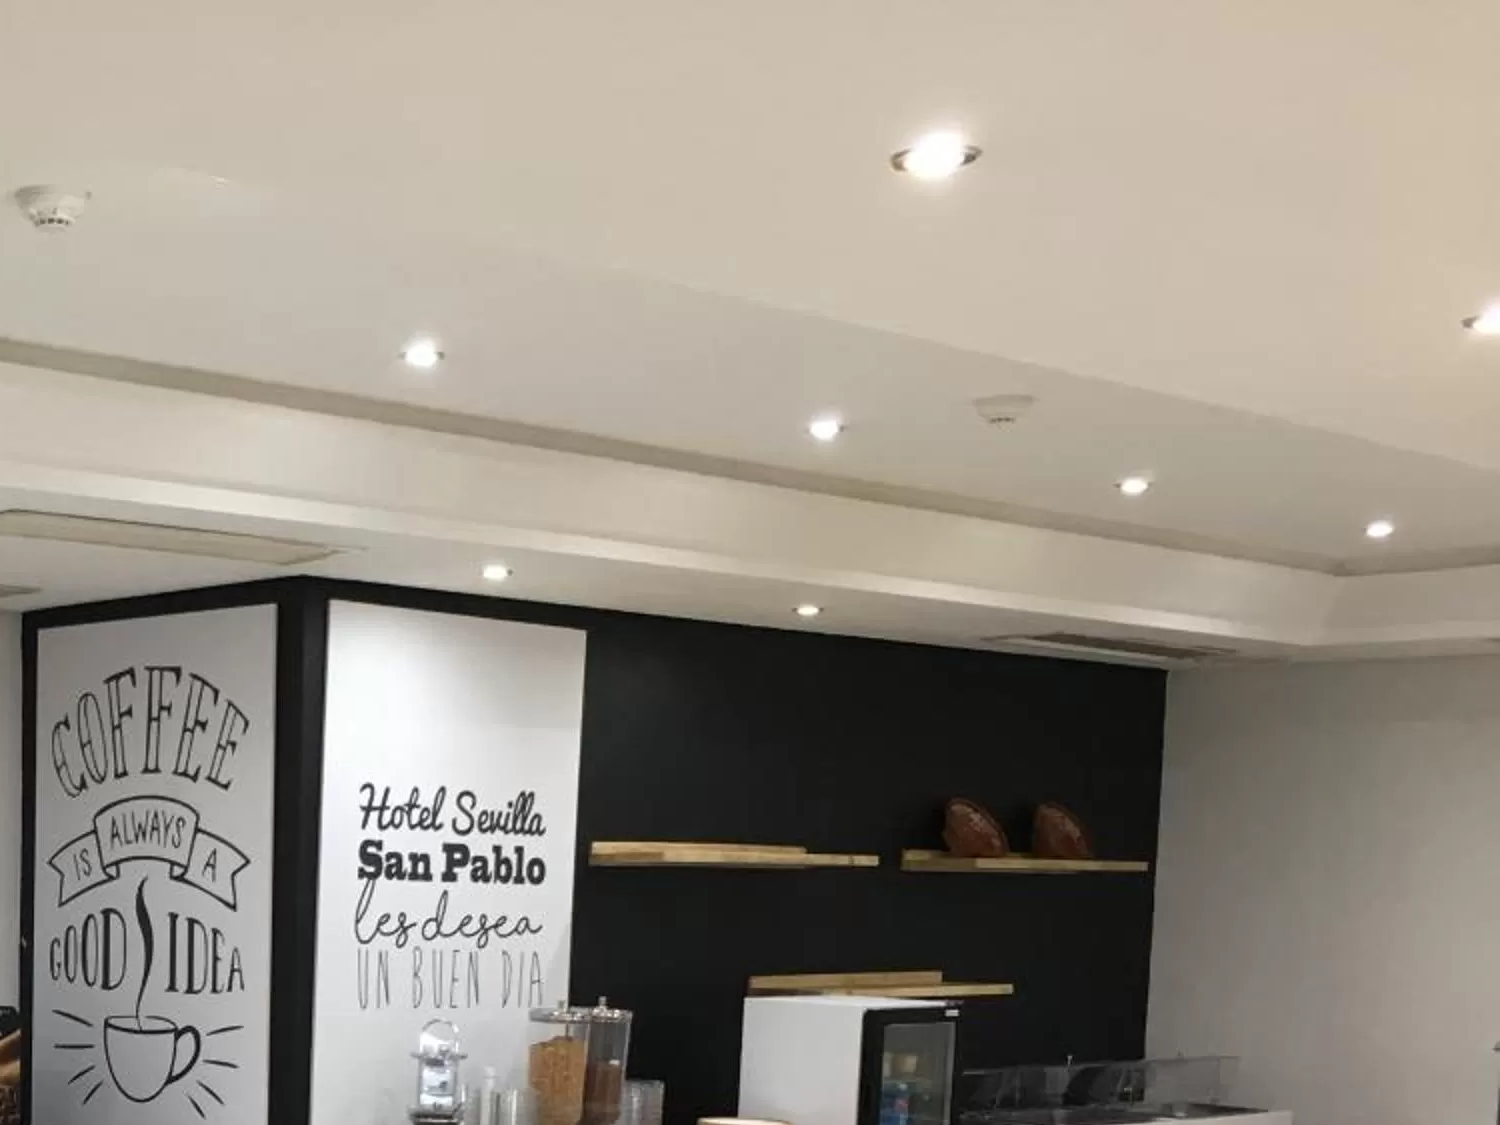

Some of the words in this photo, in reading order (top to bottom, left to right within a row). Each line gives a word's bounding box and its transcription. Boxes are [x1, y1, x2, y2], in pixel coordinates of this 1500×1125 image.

[50, 665, 250, 798] COFFEE
[73, 847, 93, 881] IS
[108, 808, 187, 850] ALWAYS
[203, 847, 219, 883] A
[359, 781, 446, 831] Hotel
[451, 789, 546, 837] Sevilla
[357, 838, 433, 882] San
[441, 842, 546, 885] Pablo
[355, 876, 418, 949] les
[421, 889, 543, 949] desea
[49, 907, 127, 991] GOOD
[165, 911, 245, 994] IDEA
[357, 947, 390, 1010] UN
[412, 945, 479, 1009] BUEN
[501, 949, 545, 1009] DIA
